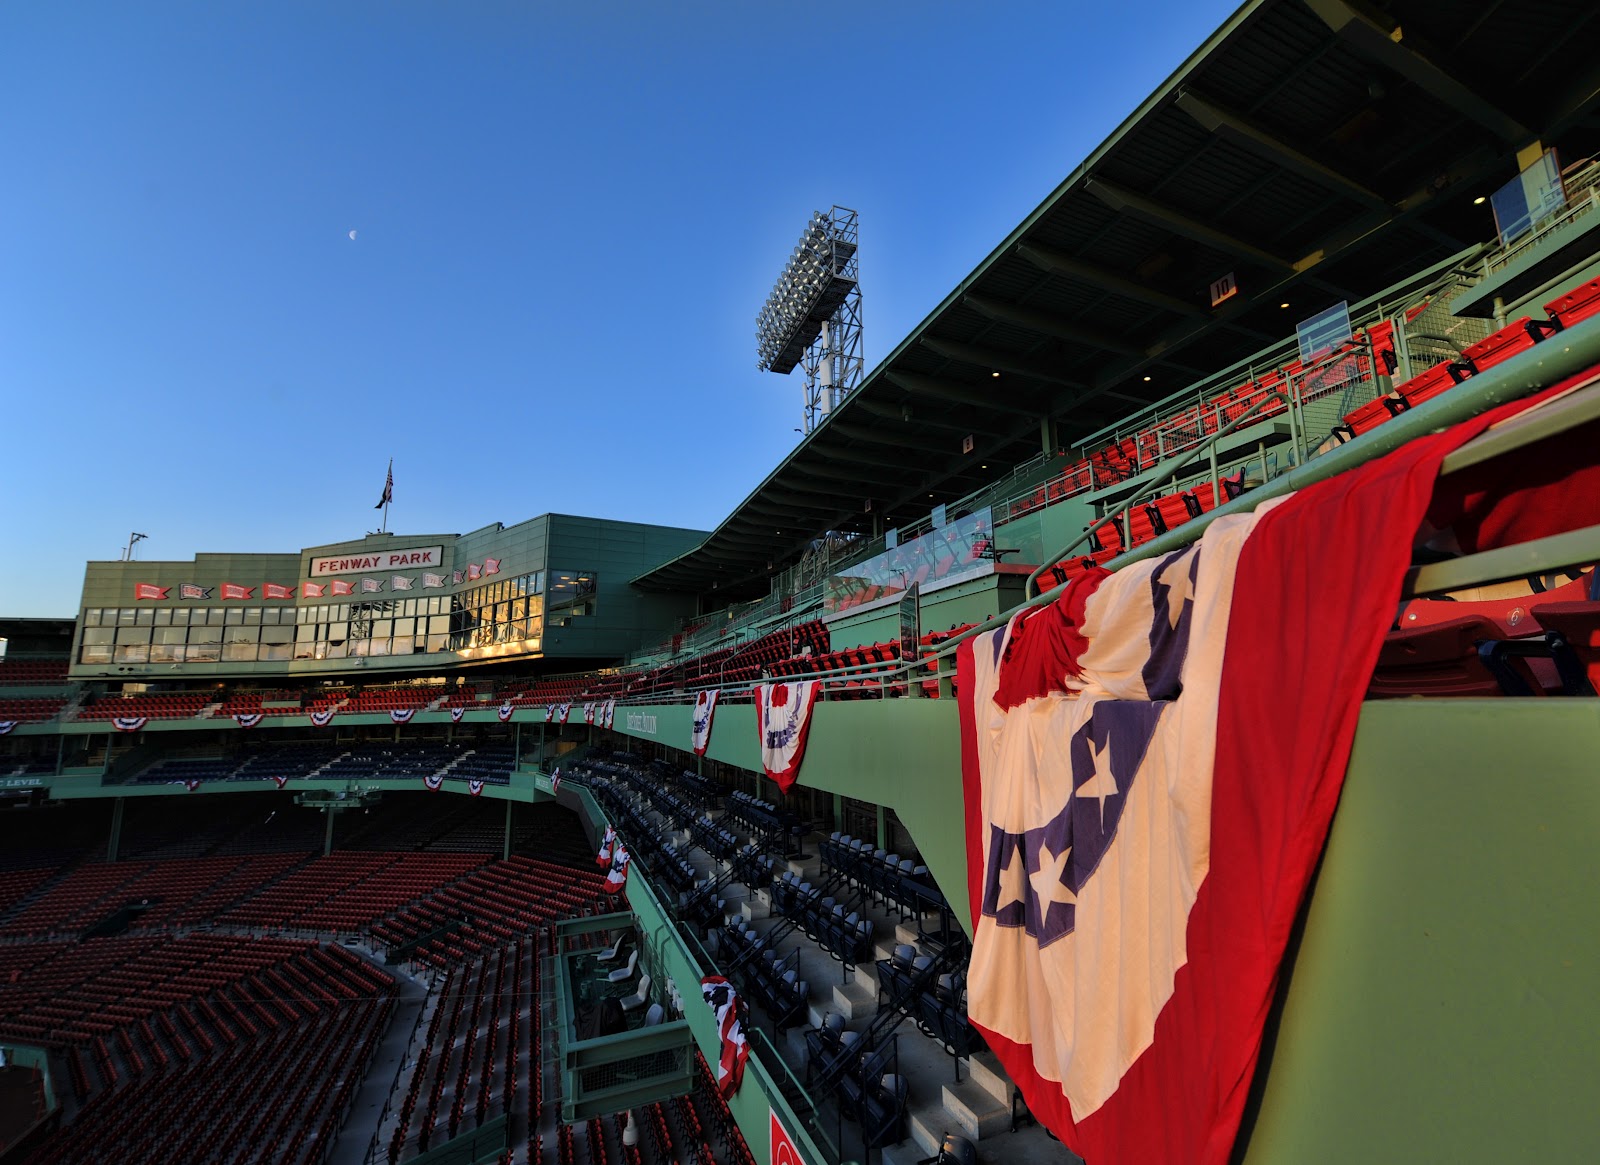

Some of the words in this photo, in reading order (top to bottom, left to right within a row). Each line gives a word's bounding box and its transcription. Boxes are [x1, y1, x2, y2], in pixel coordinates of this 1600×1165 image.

[1216, 279, 1229, 299] 10
[319, 556, 381, 572] FENWAY
[389, 551, 432, 566] PARK
[1511, 610, 1520, 622] 6
[6, 779, 42, 787] LEVEL
